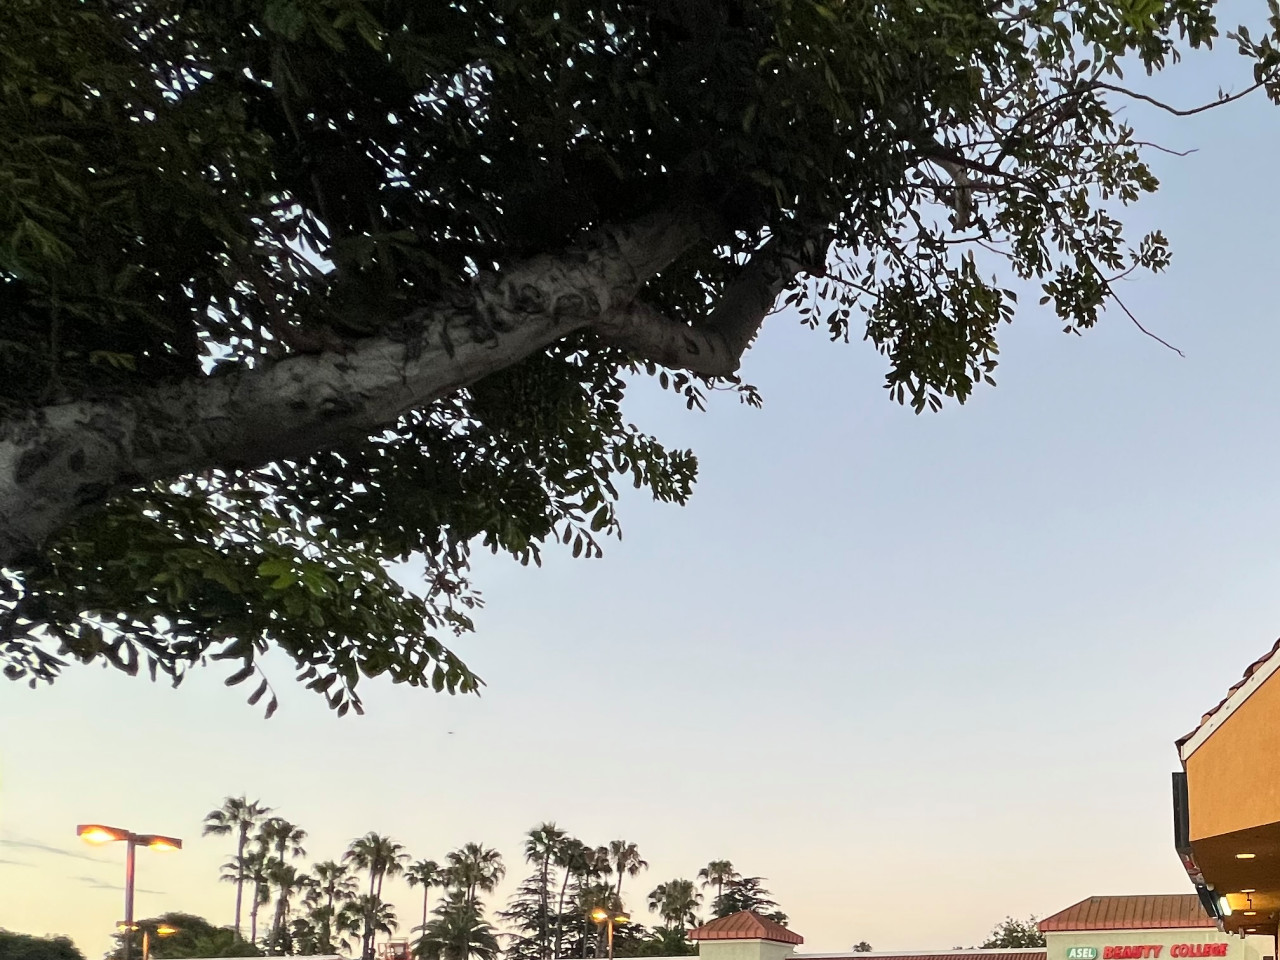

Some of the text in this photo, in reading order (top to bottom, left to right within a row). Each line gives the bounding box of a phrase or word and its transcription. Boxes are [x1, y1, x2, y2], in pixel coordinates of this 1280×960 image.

[1068, 943, 1228, 959] ASEL BEAUTY COLLEGE
